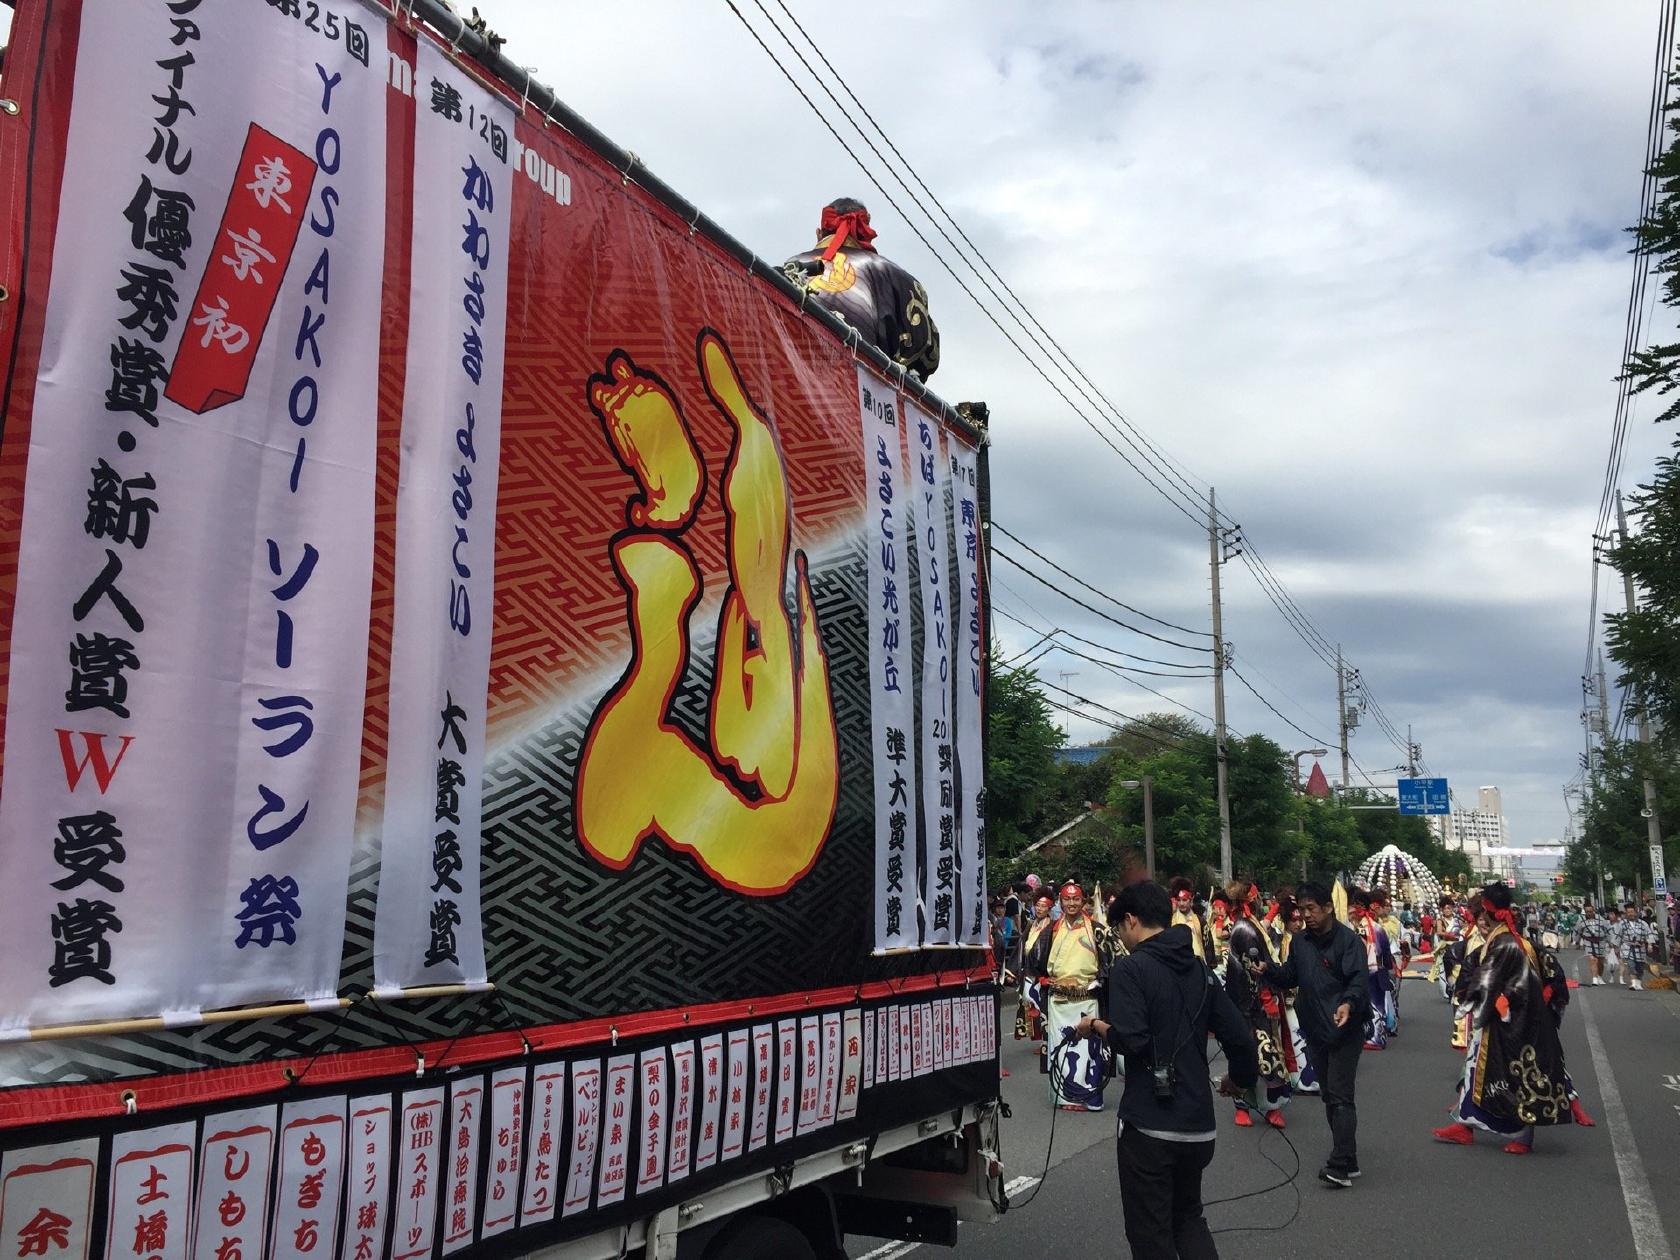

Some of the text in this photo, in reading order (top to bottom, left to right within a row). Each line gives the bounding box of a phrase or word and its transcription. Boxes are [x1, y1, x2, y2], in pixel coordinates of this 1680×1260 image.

[430, 76, 507, 164] 第12回
[194, 157, 292, 353] 東京初
[863, 385, 895, 427] 第10回
[423, 690, 468, 968] 大賞受賞
[133, 1165, 169, 1260] 土橋
